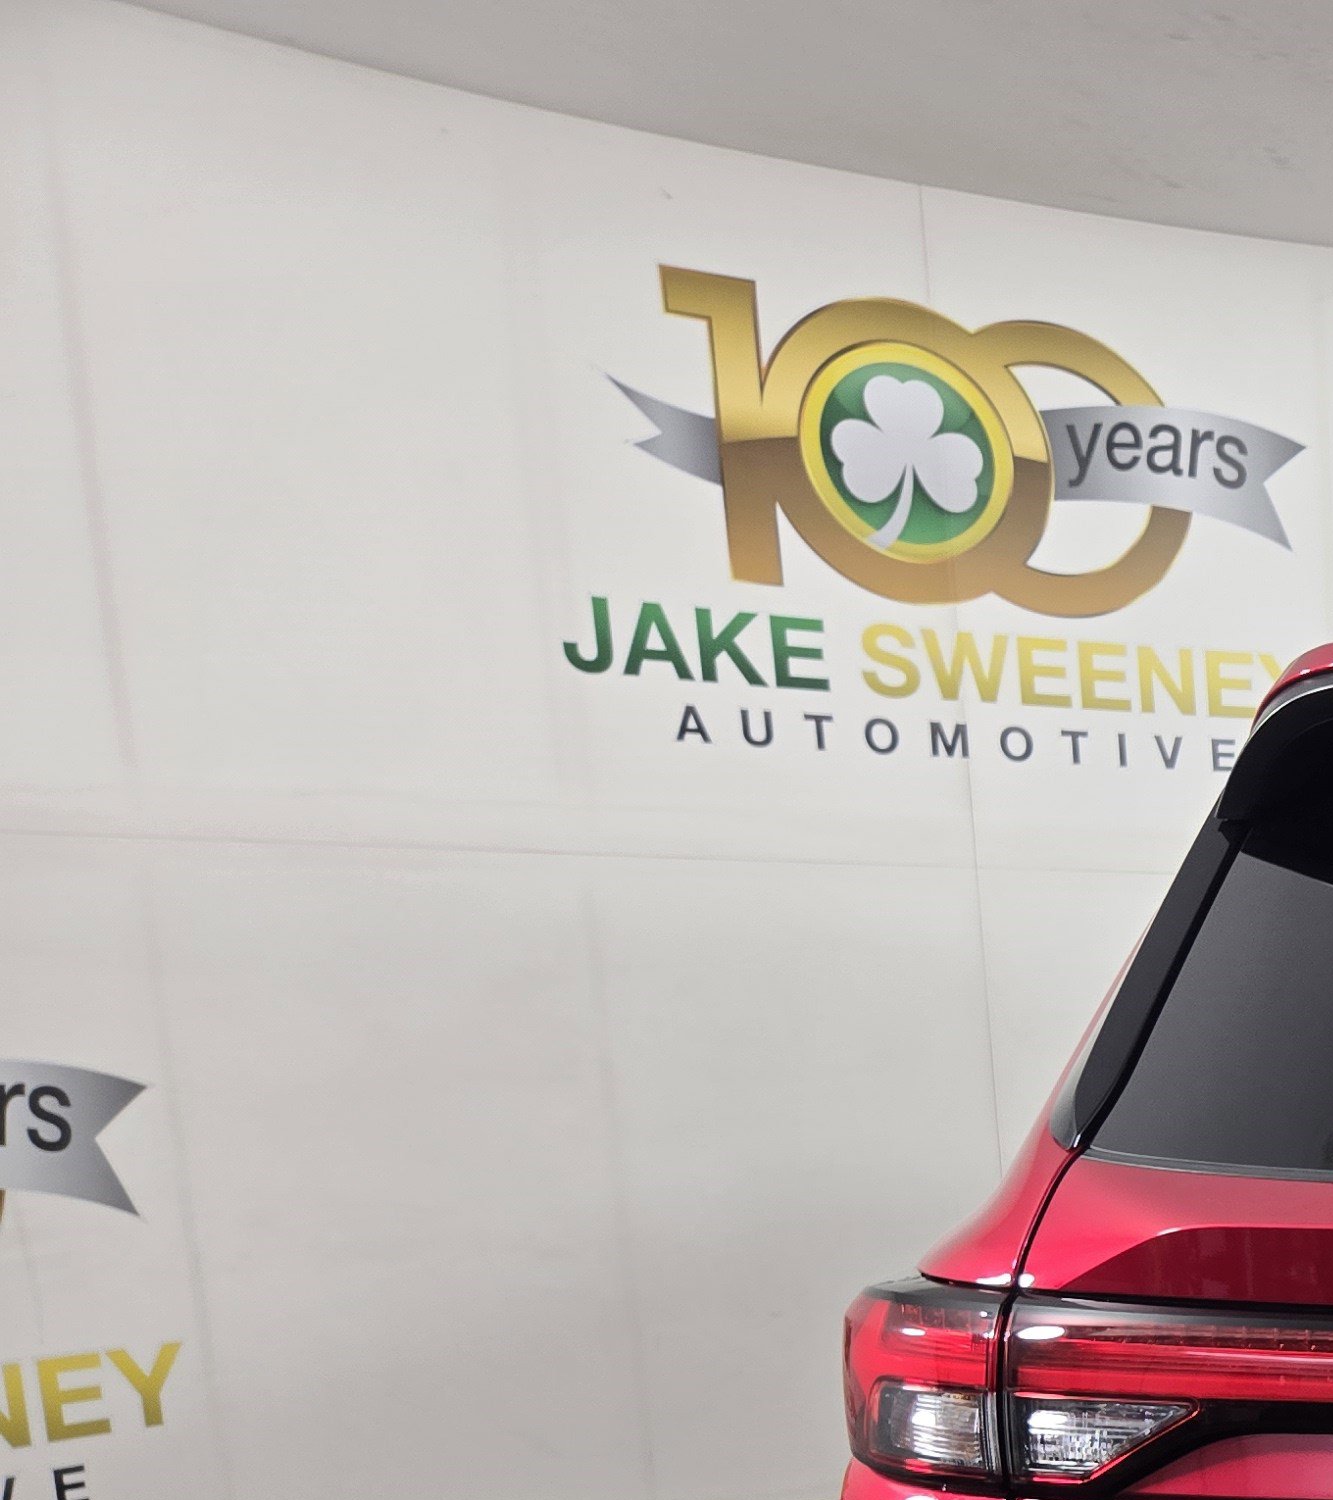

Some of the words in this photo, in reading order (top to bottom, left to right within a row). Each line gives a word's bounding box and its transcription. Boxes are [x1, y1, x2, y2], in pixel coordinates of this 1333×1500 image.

[658, 263, 1193, 618] 100
[1065, 417, 1249, 489] years
[562, 595, 830, 691] JAKE
[676, 704, 1236, 772] AUTOMOTIVE
